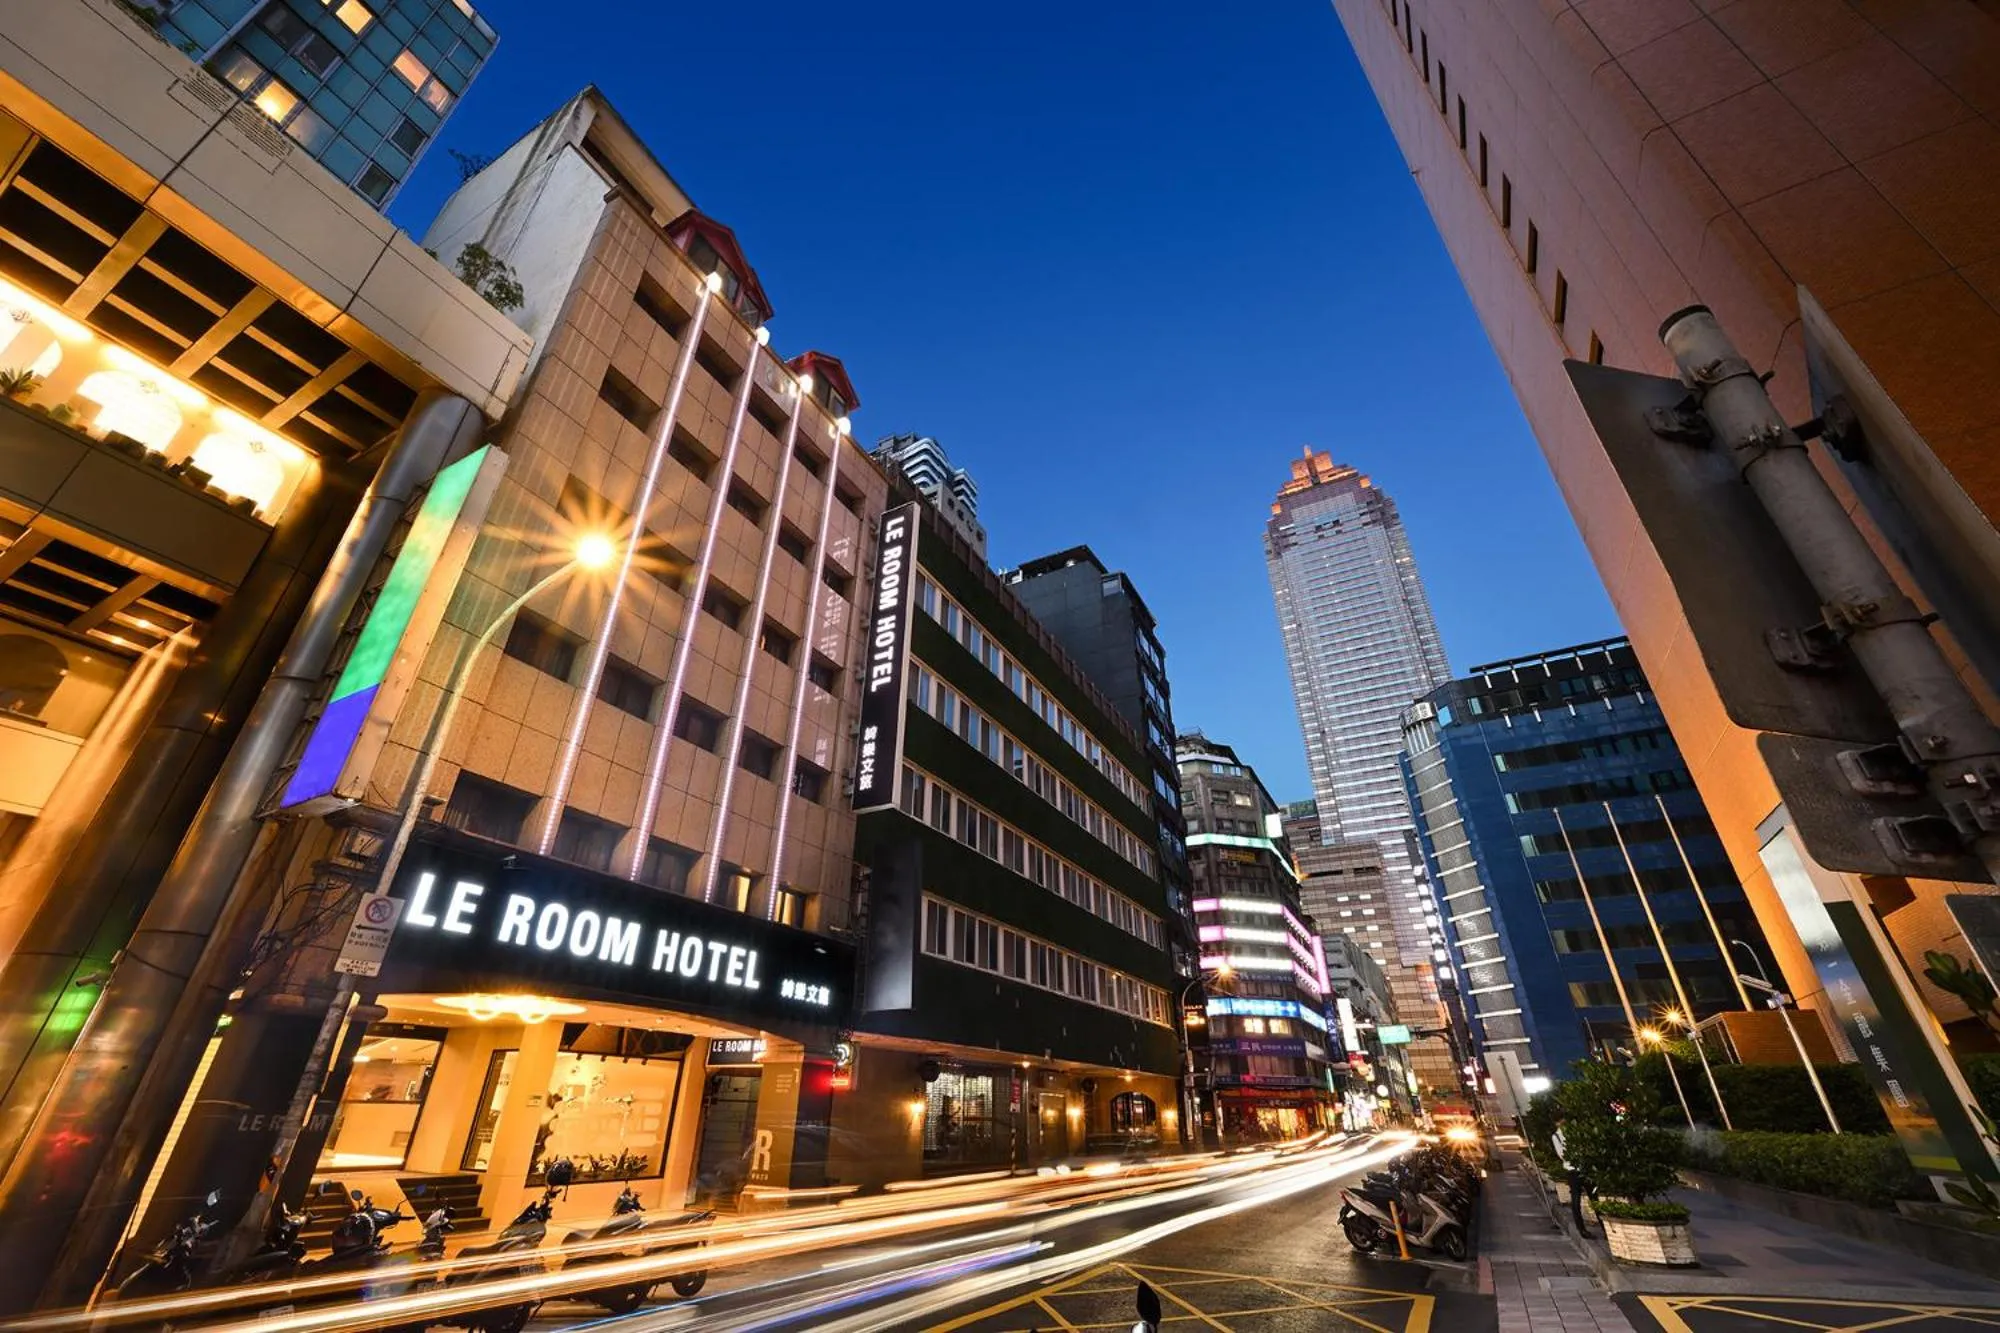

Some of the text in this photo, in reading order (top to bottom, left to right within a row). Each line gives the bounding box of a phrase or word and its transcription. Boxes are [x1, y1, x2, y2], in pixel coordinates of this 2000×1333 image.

[870, 516, 904, 692] LE ROOM HOTEL
[405, 872, 761, 989] LE ROOM HOTEL
[712, 1041, 724, 1052] LE
[725, 1040, 752, 1052] ROOM
[238, 1114, 330, 1132] LE RM
[754, 1130, 773, 1171] R
